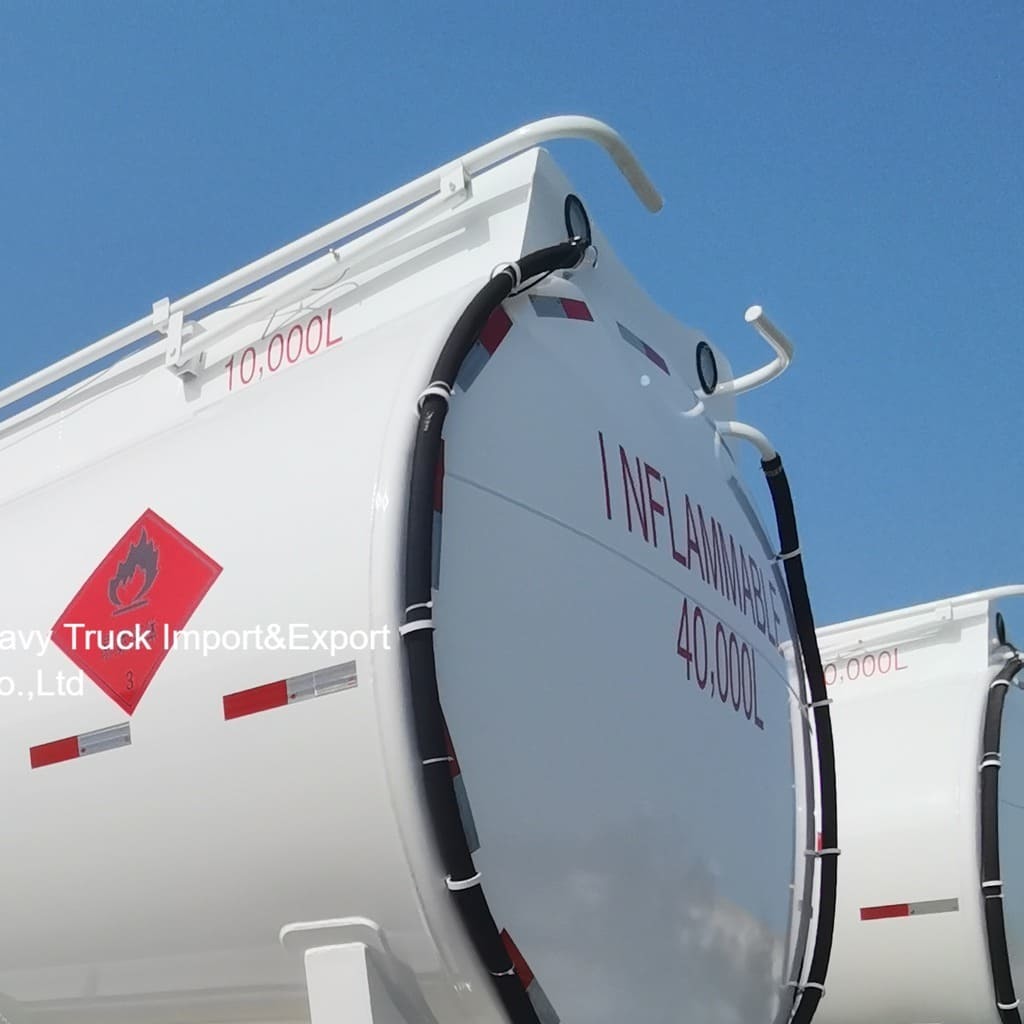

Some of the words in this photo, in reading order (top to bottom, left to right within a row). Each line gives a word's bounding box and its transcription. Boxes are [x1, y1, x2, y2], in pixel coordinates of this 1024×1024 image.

[224, 307, 343, 391] 10,000L
[125, 670, 134, 690] 3
[676, 597, 764, 730] 40,000L
[824, 648, 908, 686] 0,000L
